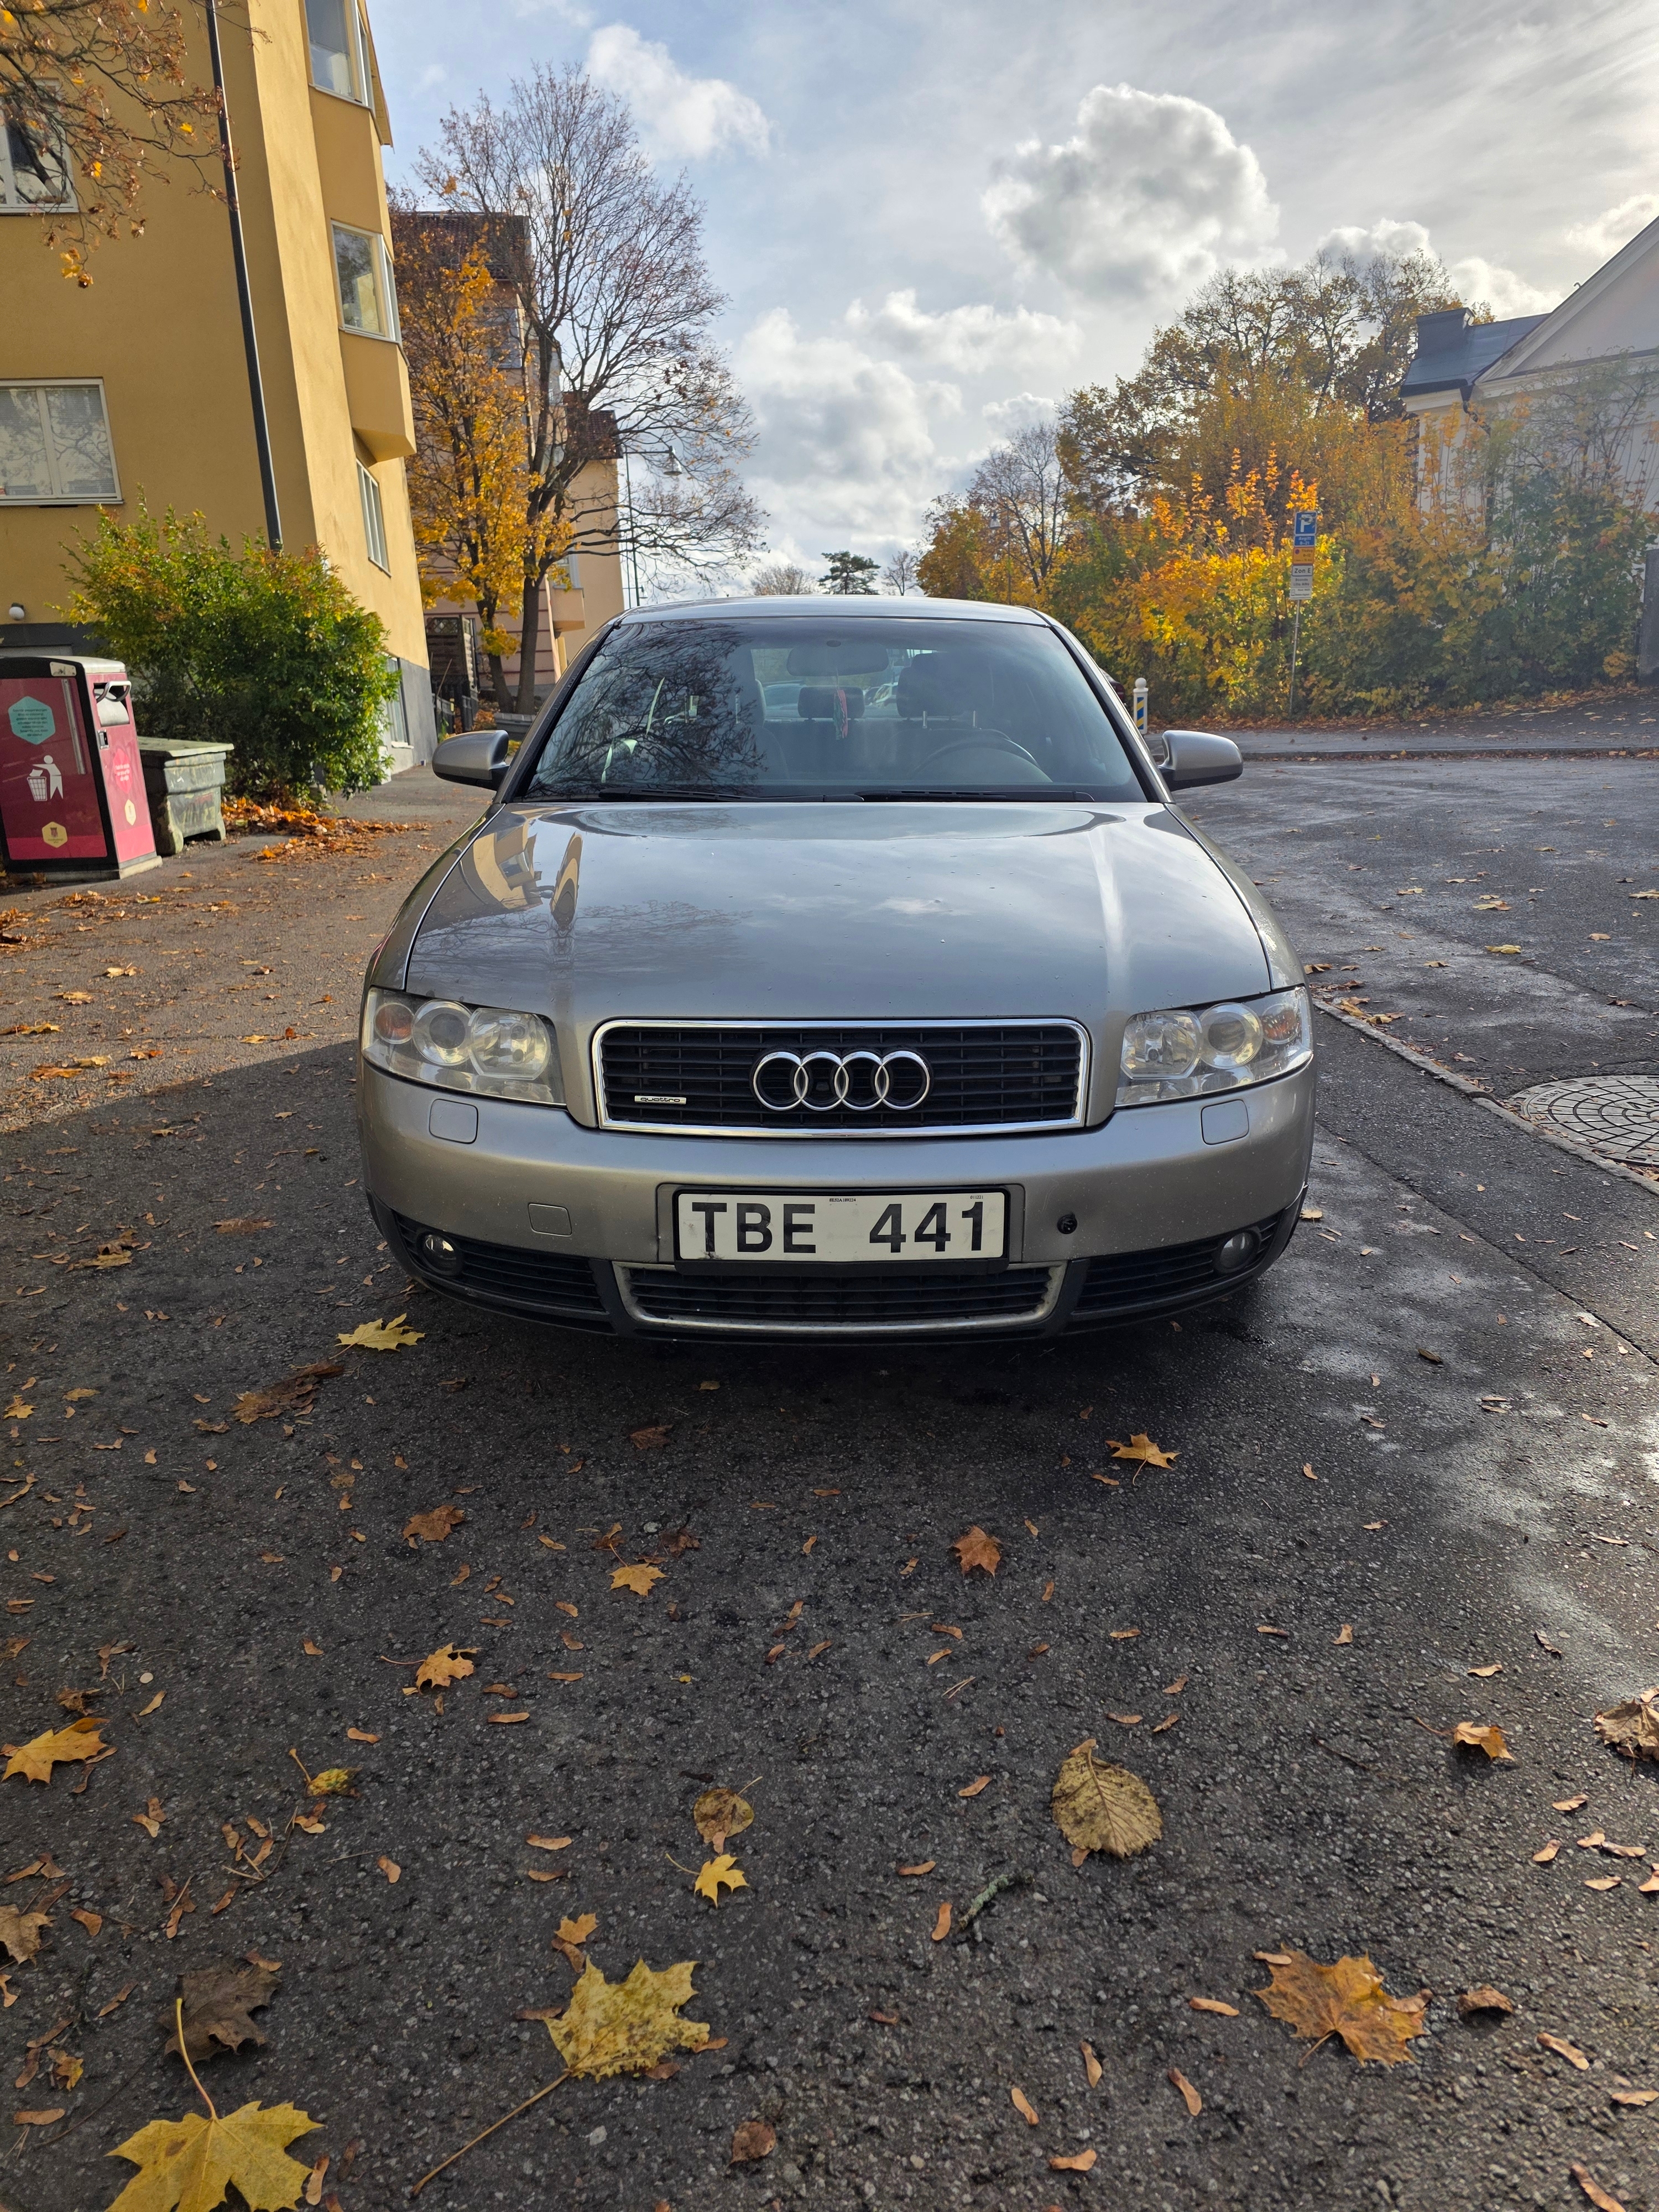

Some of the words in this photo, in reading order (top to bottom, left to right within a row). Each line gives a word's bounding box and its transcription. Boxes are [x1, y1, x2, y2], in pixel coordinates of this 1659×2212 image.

[1300, 514, 1313, 533] P
[691, 1202, 817, 1253] TBE
[869, 1201, 984, 1253] 441
